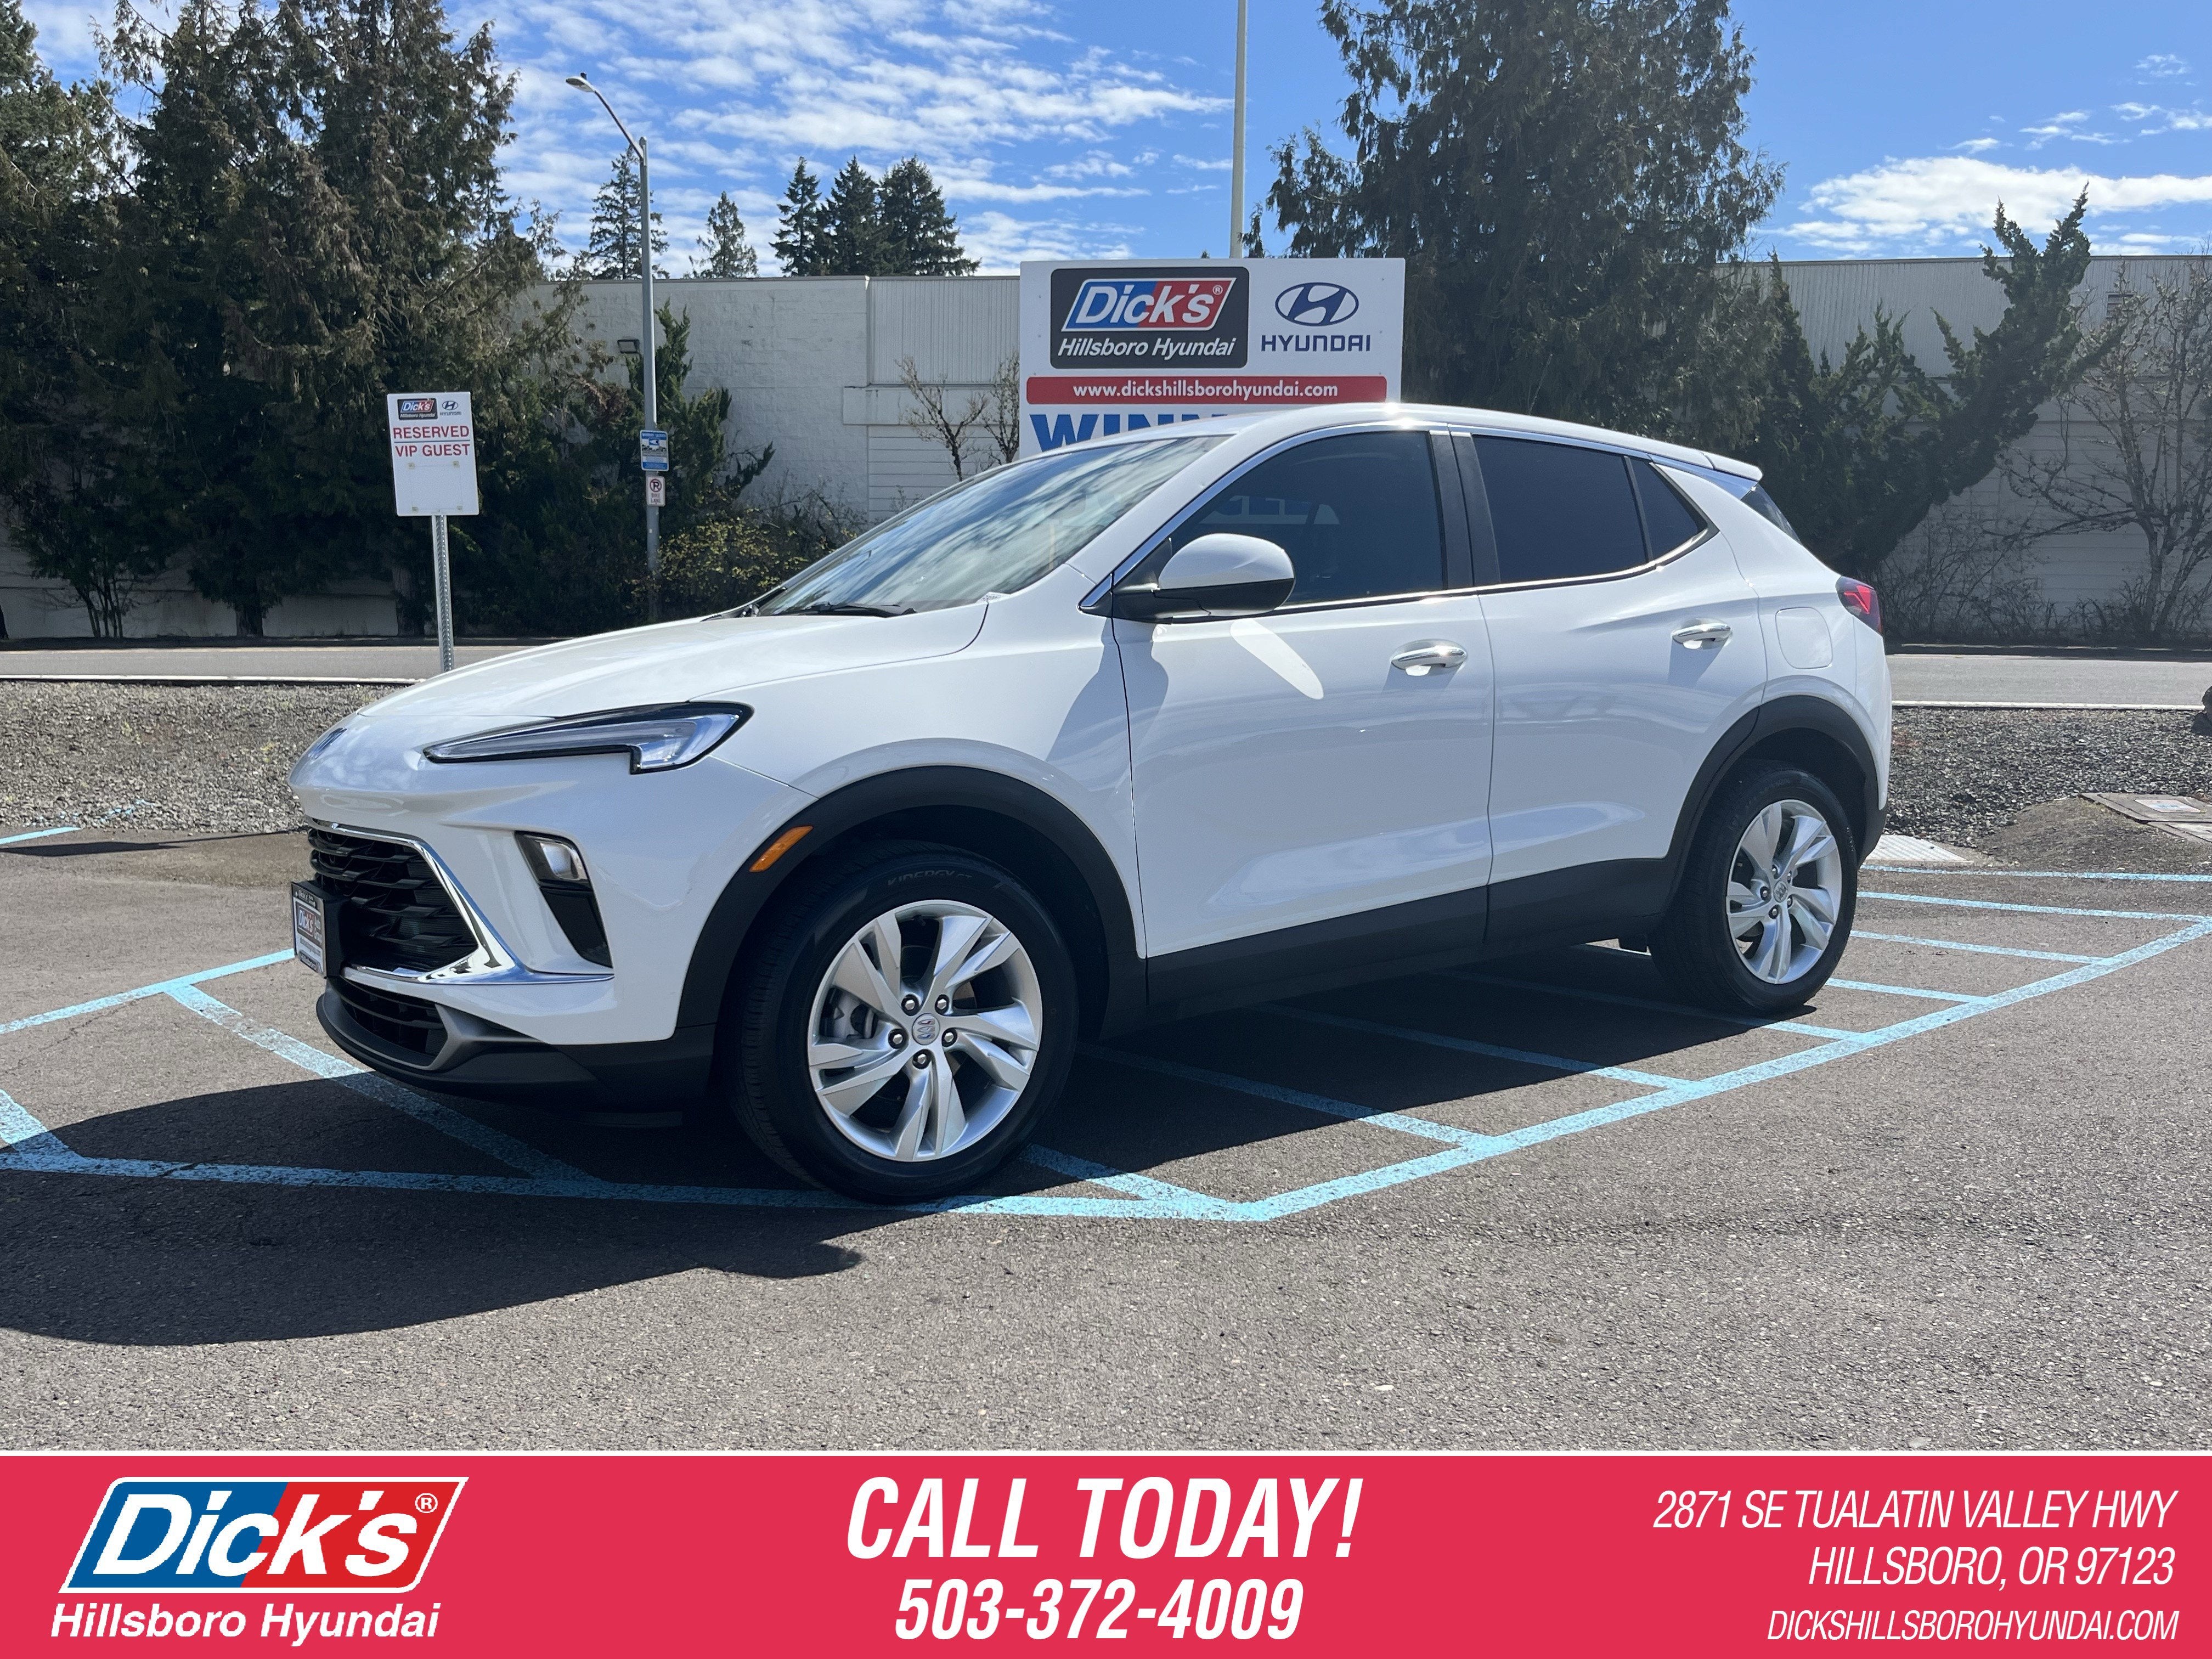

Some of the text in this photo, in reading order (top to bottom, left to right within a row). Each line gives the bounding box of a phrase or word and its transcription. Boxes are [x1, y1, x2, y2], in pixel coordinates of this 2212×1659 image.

[1058, 337, 1237, 360] Hillsboro Hyundai
[1261, 334, 1370, 352] HYUNDAI
[1073, 379, 1339, 400] www.dickshillsborohyundai.com
[393, 425, 470, 439] RESERVED
[395, 443, 470, 457] VIP GUEST
